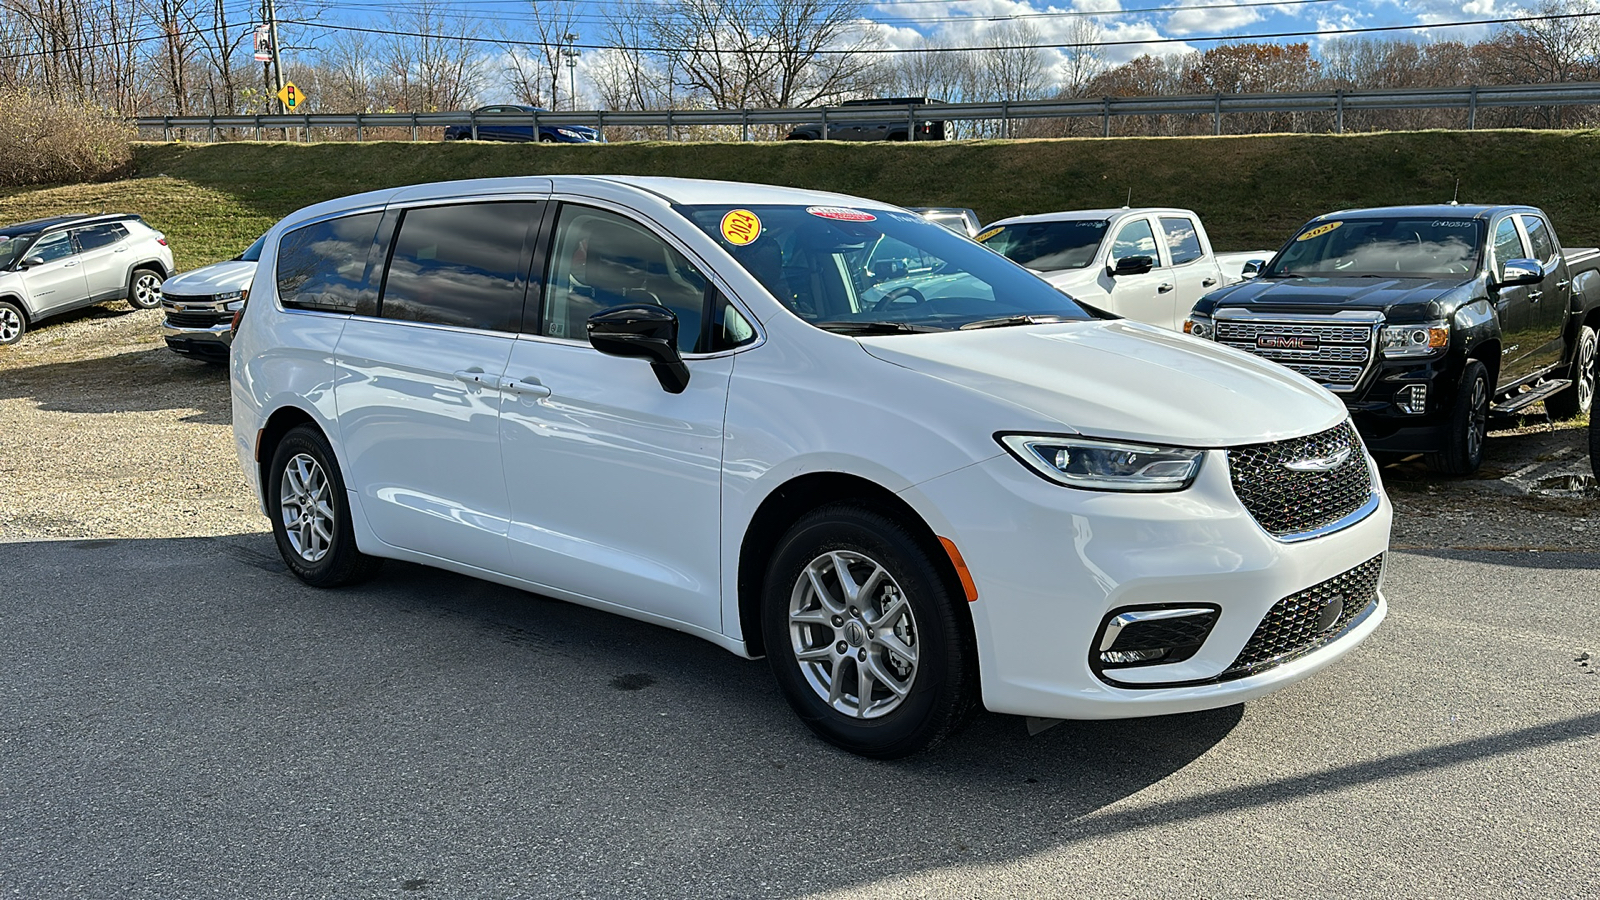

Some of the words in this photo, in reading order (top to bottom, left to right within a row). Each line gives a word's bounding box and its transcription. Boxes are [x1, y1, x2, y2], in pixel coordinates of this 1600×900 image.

[727, 212, 754, 242] 2024
[1304, 223, 1334, 239] 2021
[1257, 336, 1318, 349] GMC
